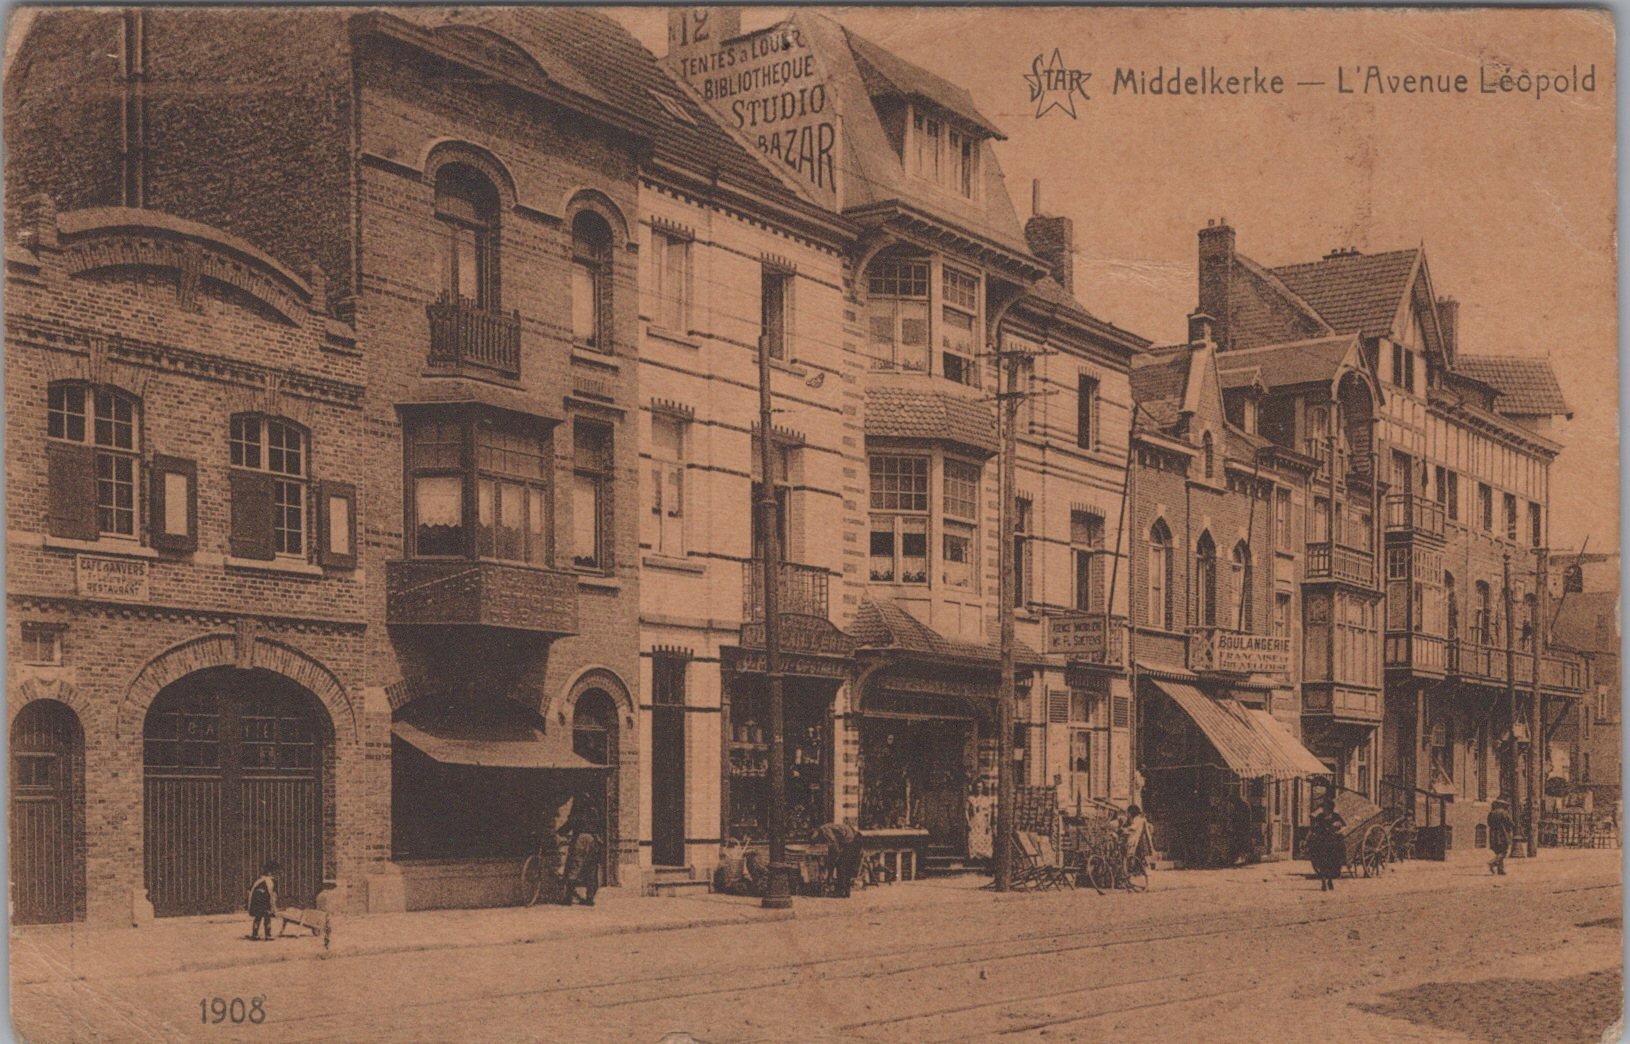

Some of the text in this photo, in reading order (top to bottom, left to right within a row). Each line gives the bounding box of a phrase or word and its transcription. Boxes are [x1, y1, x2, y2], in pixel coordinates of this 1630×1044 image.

[681, 46, 736, 80] TENTES
[732, 84, 826, 129] STUDIO
[758, 122, 837, 194] BAZAR
[1219, 635, 1290, 652] BOULANGERIE
